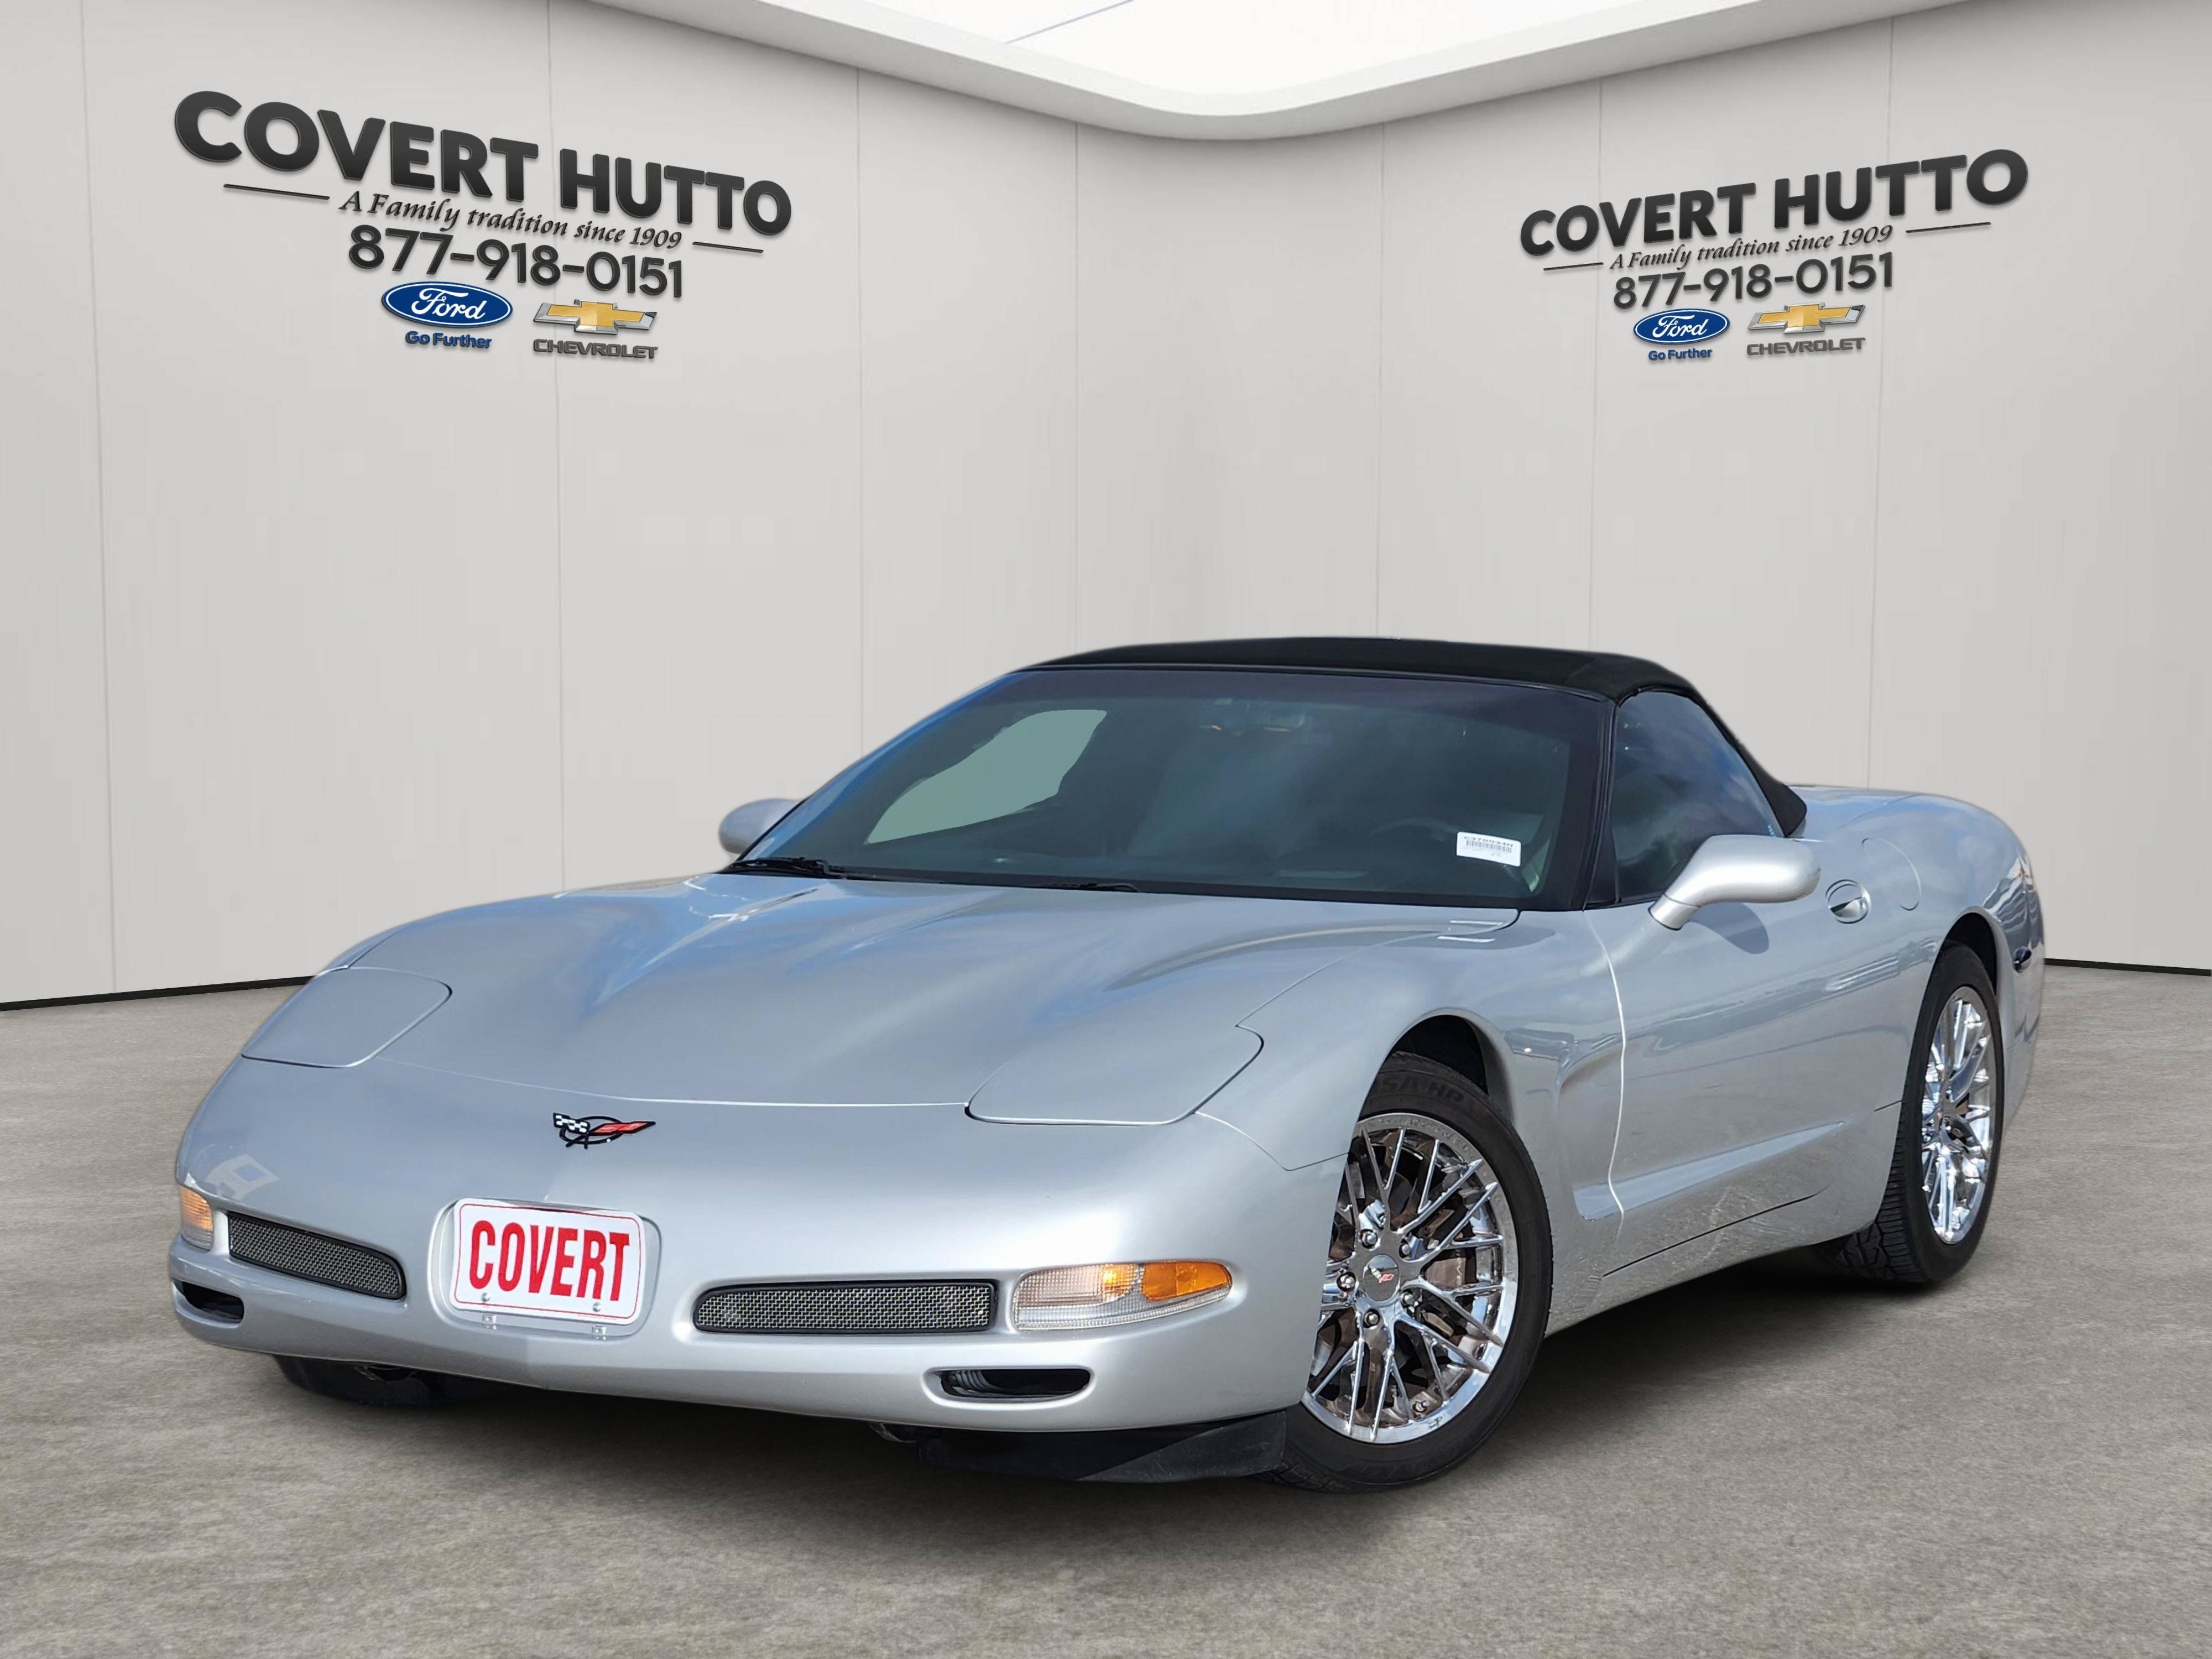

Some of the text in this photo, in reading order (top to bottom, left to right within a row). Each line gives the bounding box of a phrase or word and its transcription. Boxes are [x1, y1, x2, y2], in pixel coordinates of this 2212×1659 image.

[174, 91, 791, 236] COVERT HUTTO
[338, 191, 682, 249] A Family tradition since 1909
[1521, 149, 2028, 257] COVERT HUTTO
[349, 225, 682, 298] 877-918-0151
[1609, 225, 1893, 270] A Family tradition since 1909
[1614, 252, 1892, 309] 877-918-0151
[411, 288, 487, 320] Ford
[1652, 315, 1707, 338] Ford
[405, 331, 492, 349] Go Further
[533, 338, 659, 359] CHEVROLET
[1648, 348, 1712, 361] Go Further
[1746, 337, 1866, 356] CHEVROLET
[470, 1220, 629, 1301] COVERT
